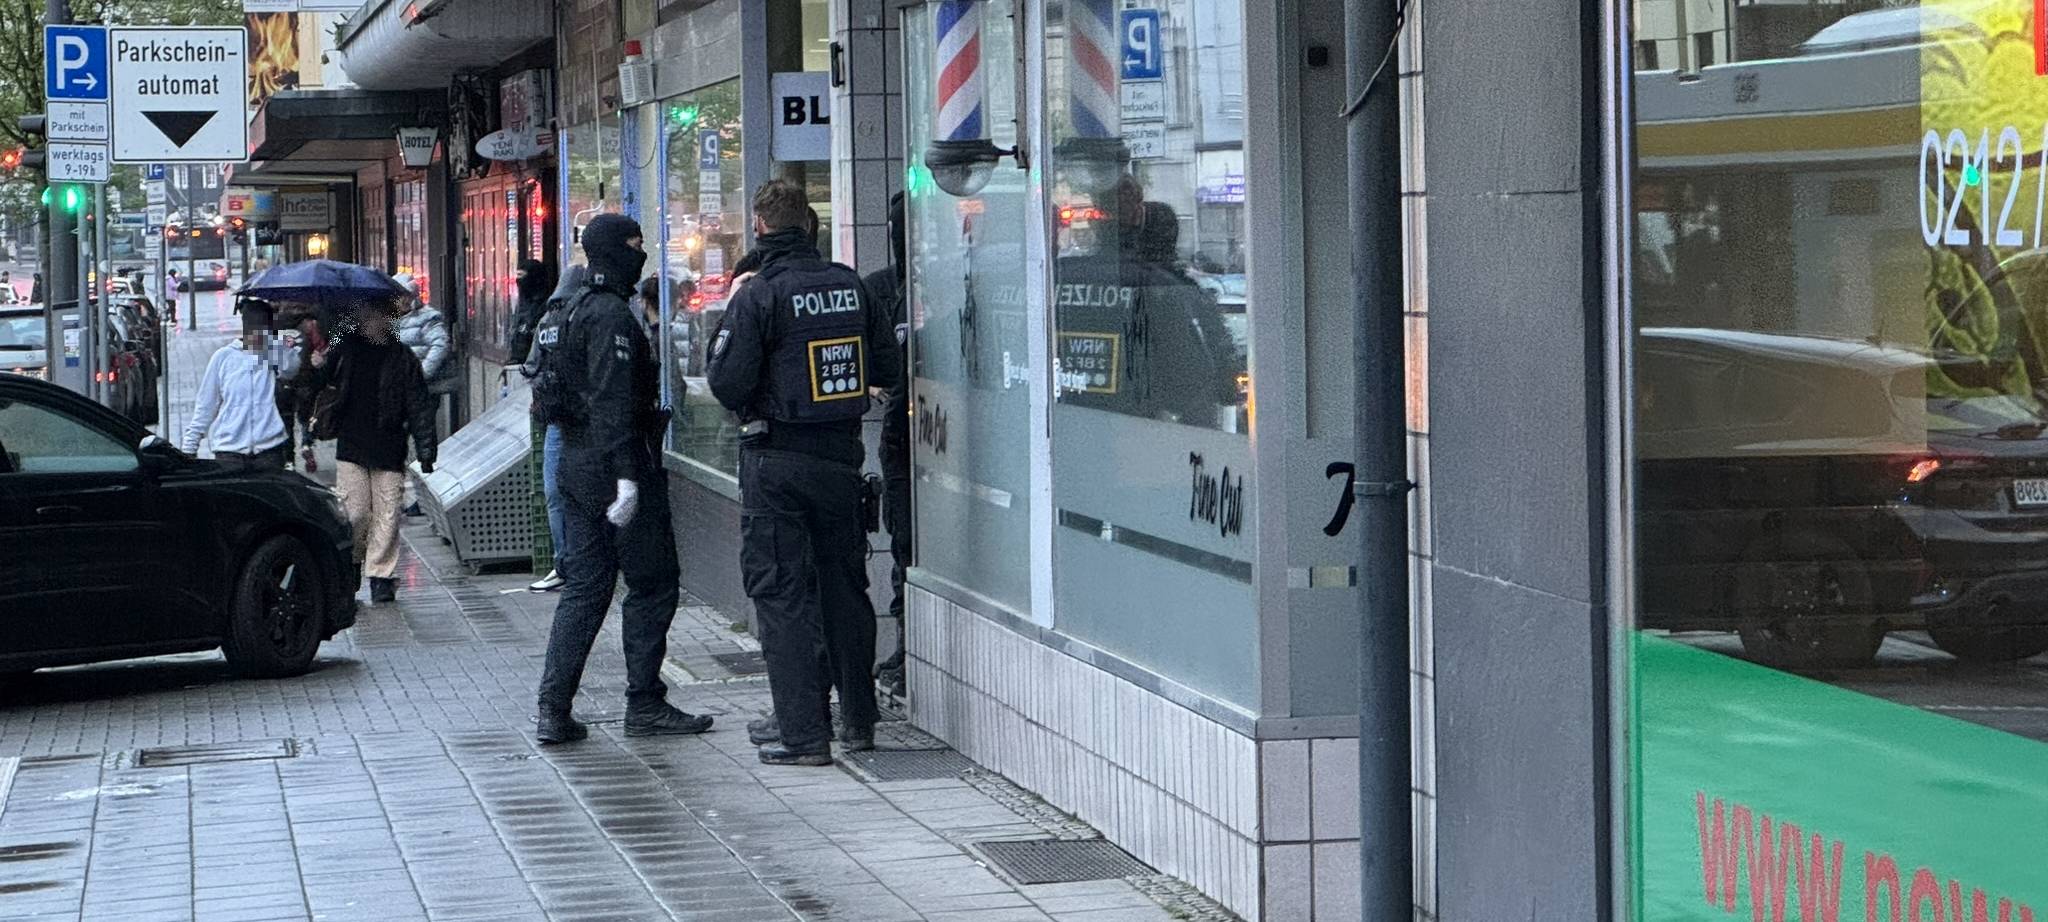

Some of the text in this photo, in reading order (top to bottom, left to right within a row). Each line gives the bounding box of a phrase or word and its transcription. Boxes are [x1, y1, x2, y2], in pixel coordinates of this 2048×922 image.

[117, 40, 238, 62] Parkschein-
[55, 35, 89, 90] P
[138, 74, 220, 95] automat
[69, 110, 86, 121] mit
[51, 121, 105, 133] Parkschein
[404, 136, 433, 148] HOTEL
[51, 149, 105, 164] werktags
[792, 289, 860, 318] POLIZEI
[822, 344, 853, 362] NRW
[821, 362, 856, 377] 2 BF 2
[1190, 451, 1217, 525] Fine
[1220, 465, 1242, 538] Cut
